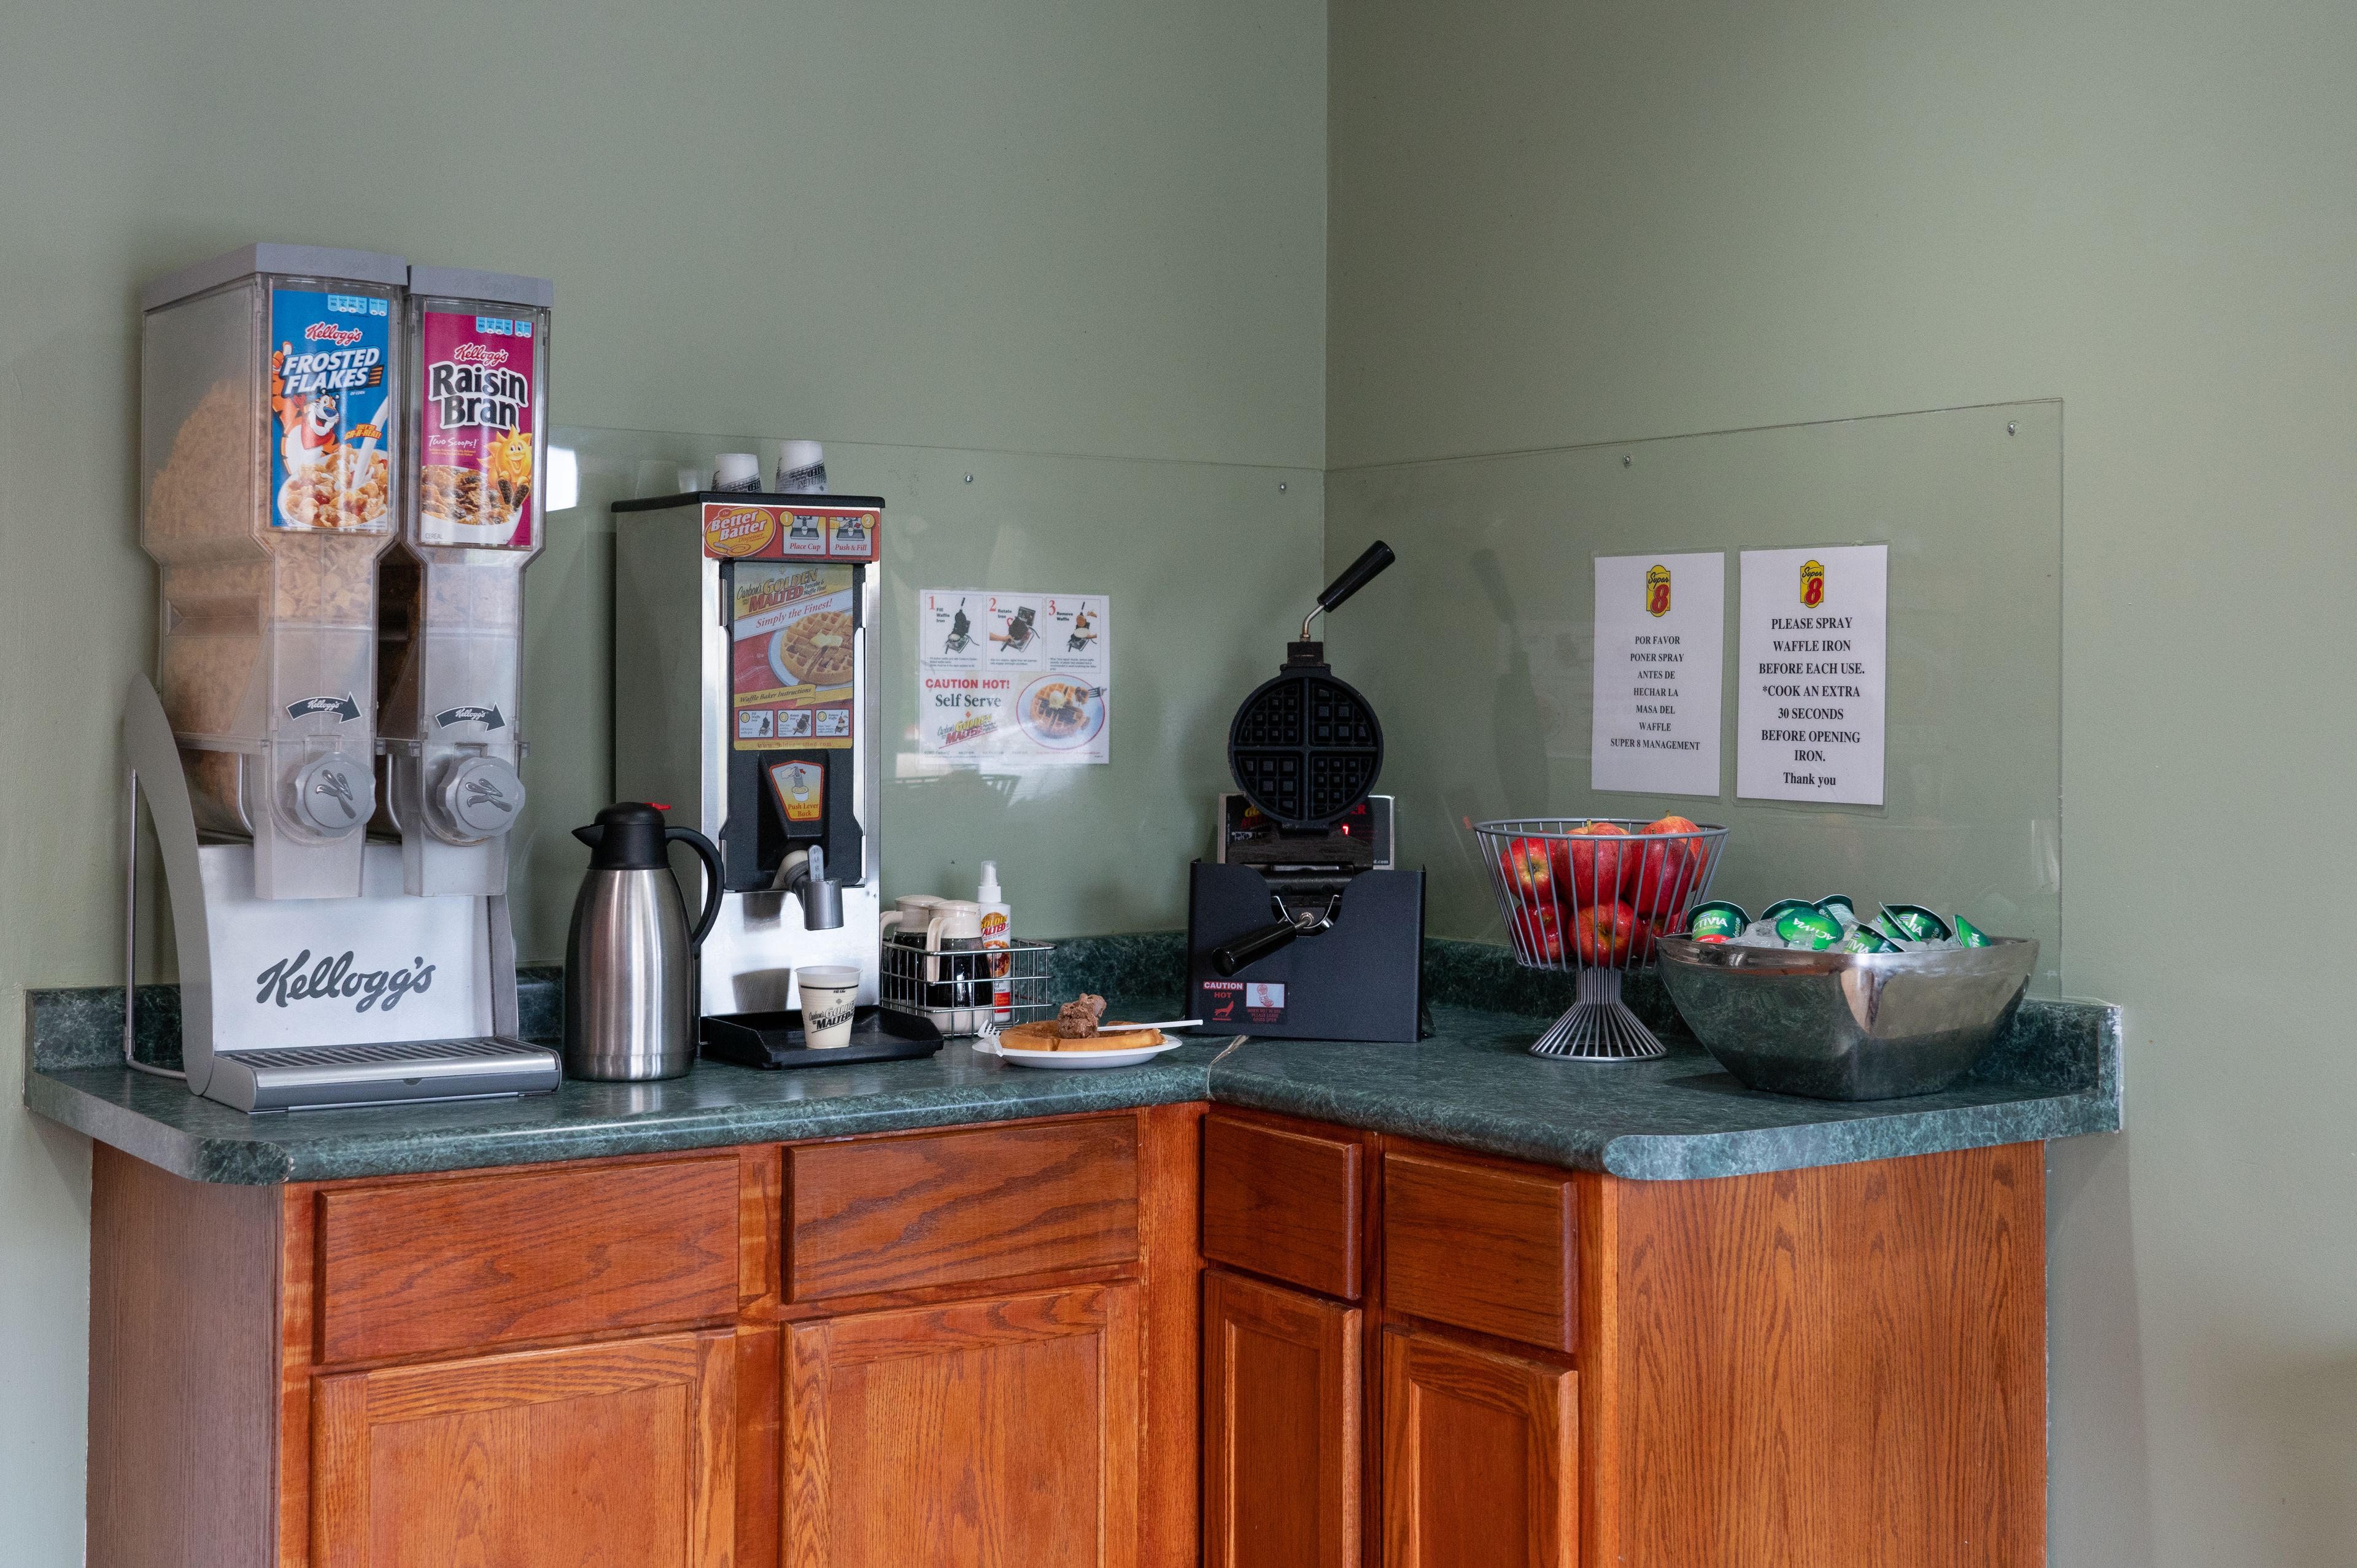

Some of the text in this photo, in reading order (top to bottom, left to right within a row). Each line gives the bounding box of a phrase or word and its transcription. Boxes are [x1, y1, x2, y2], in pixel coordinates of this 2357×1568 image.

[306, 322, 362, 345] Kellogg's
[282, 347, 380, 376] FROSTED
[455, 344, 508, 365] Kellogg's
[284, 367, 369, 395] FLAKES
[433, 364, 527, 405] Raisin
[444, 395, 517, 428] Bran
[428, 435, 477, 449] Two Scoops!
[710, 510, 759, 533] Better
[719, 520, 767, 541] Batter
[738, 533, 764, 543] Dispenser
[808, 543, 821, 552] Cup
[763, 568, 819, 595] GOLDEN
[1648, 572, 1670, 590] Super
[1802, 566, 1823, 583] Super
[737, 582, 762, 600] Carbon's
[1804, 577, 1823, 605] 8
[748, 585, 804, 613] MALTED
[928, 595, 936, 610] 1
[989, 597, 997, 612] 2
[1651, 584, 1670, 614] 8
[756, 598, 834, 629] Simply the Finest!
[1048, 600, 1056, 616] 3
[1771, 617, 1852, 630] PLEASE SPRAY
[1635, 636, 1681, 645] POR FAVOR
[1773, 639, 1851, 652] WAFFLE IRON
[1630, 653, 1684, 663] PONER SPRAY
[1637, 670, 1676, 680] ANTES DE
[1759, 662, 1865, 675] BEFORE EACH USE.
[925, 678, 1010, 690] CAUTION HOT!
[1803, 685, 1819, 697] AN
[1822, 686, 1860, 697] EXTRA
[740, 695, 760, 703] Waffle
[778, 687, 812, 697] Instructions
[1633, 687, 1679, 697] HECHAR LA
[308, 698, 340, 711] Kellogg's
[935, 693, 1002, 708] Self Serve
[454, 708, 487, 720] Kellogg's
[1636, 705, 1676, 714] MASA DEL
[1778, 708, 1844, 720] 30 SECONDS
[1639, 722, 1671, 732] WAFFLE
[1761, 729, 1861, 744] BEFORE OPENING
[1610, 738, 1700, 751] SUPER 8 MANAGEMENT
[1794, 749, 1826, 762] IRON.
[1783, 771, 1836, 789] Thank you
[981, 922, 1007, 937] ALTED
[1692, 917, 1728, 933] CTIVIA
[256, 949, 436, 1013] Kellogg's
[808, 1011, 824, 1021] Carbon's
[816, 1011, 850, 1030] MALTED
